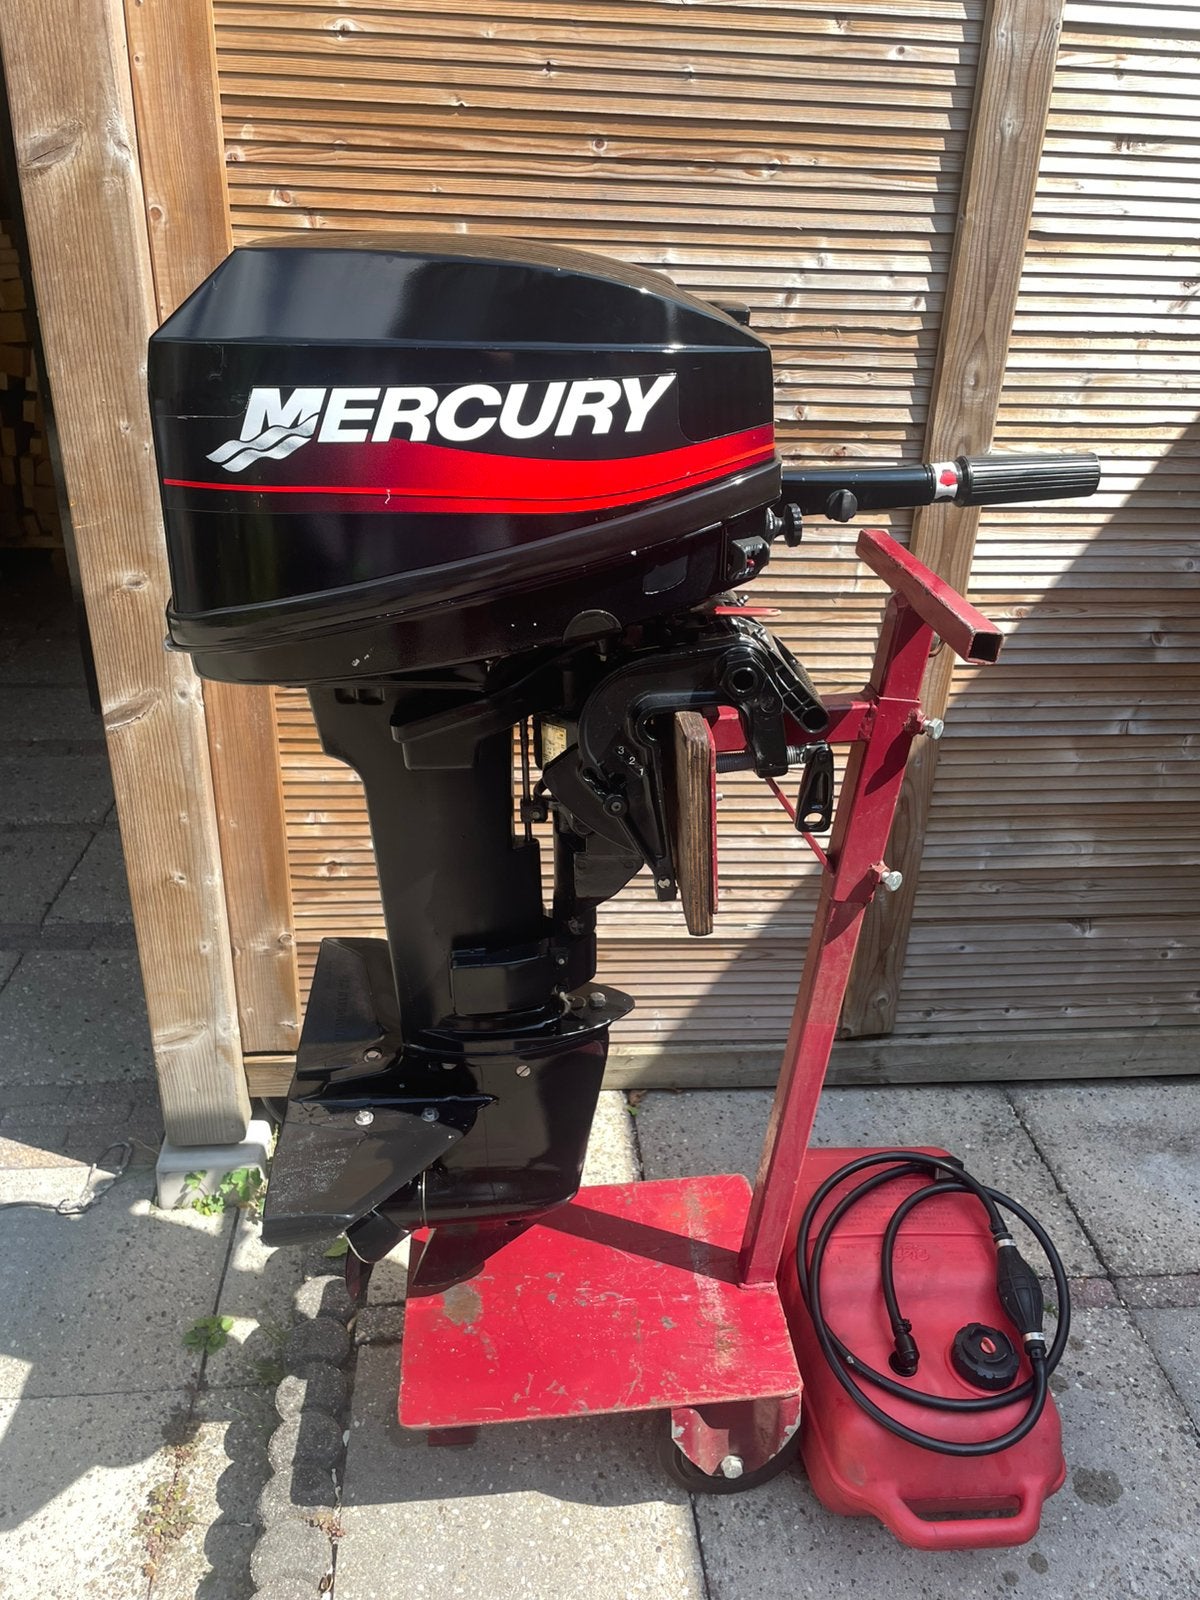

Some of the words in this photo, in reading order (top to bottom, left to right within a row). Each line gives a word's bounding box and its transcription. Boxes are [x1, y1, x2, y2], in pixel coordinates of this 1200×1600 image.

[236, 372, 677, 445] MERCURY
[617, 745, 625, 755] 3
[628, 756, 636, 765] 2
